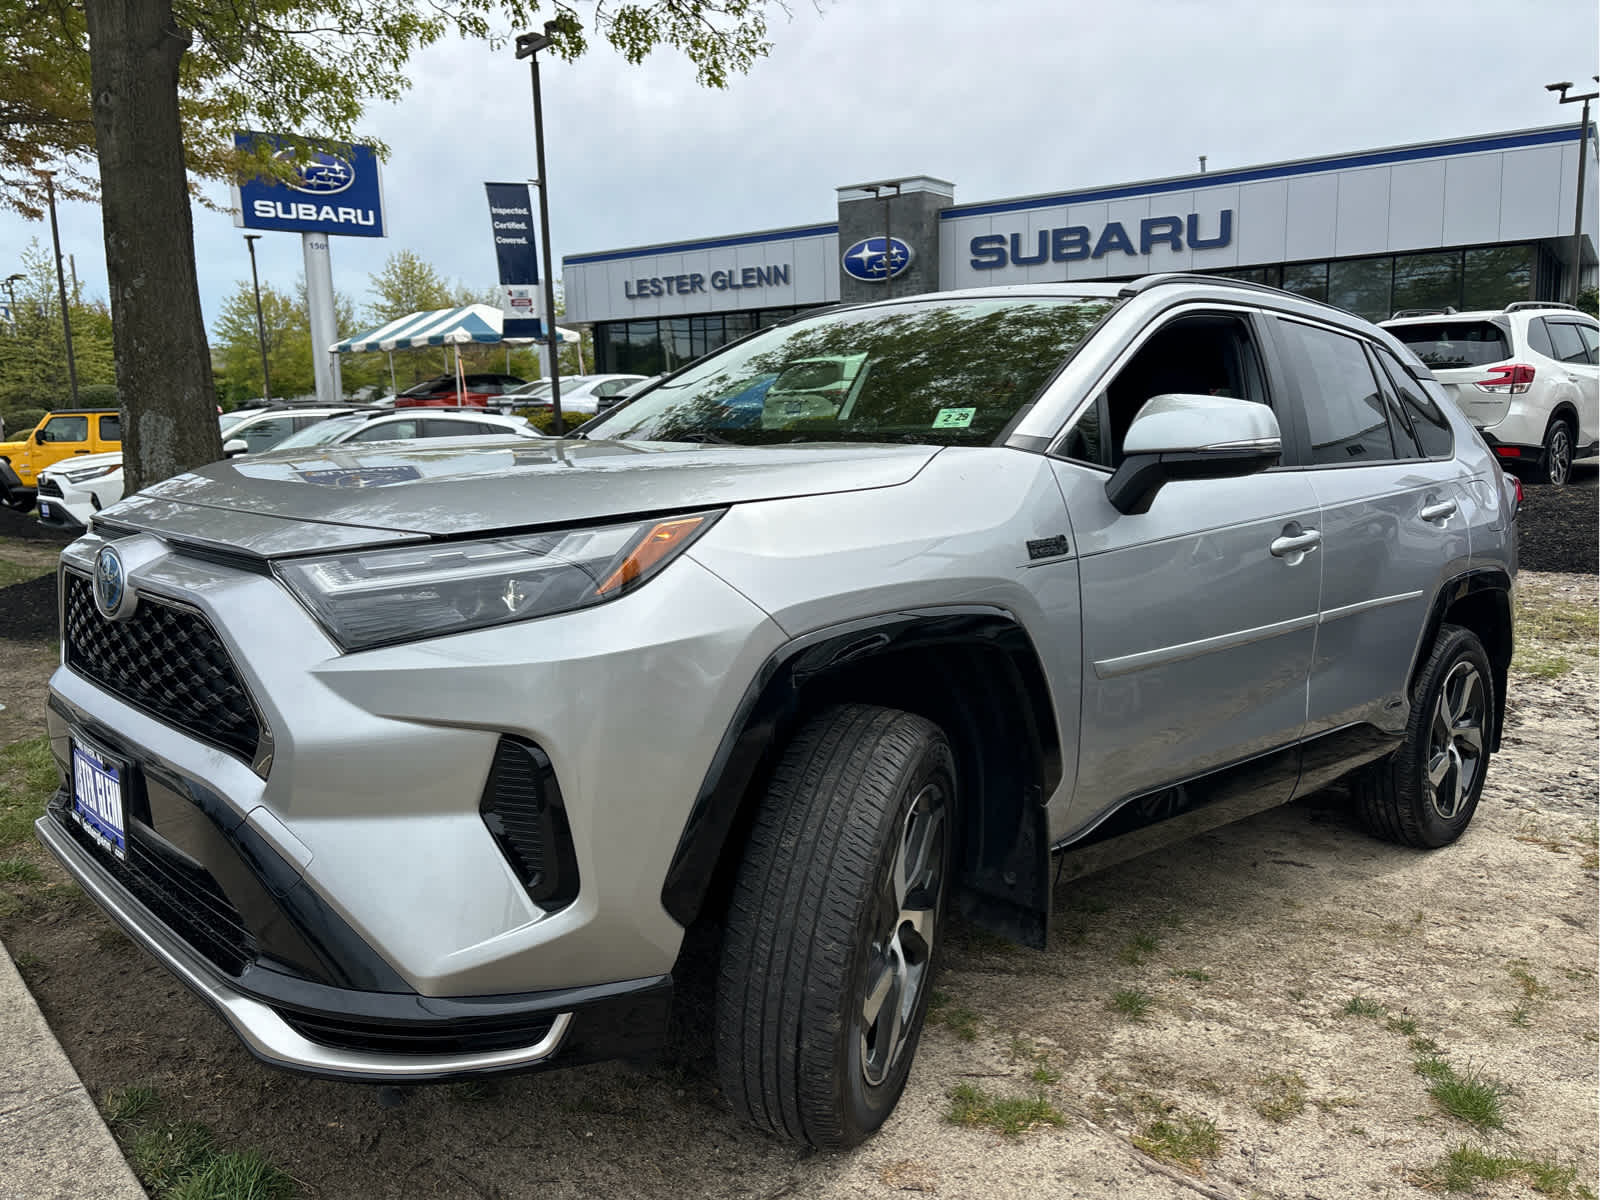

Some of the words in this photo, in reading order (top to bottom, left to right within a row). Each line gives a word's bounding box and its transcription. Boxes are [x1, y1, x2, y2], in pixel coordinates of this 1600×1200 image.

[253, 200, 375, 226] SUBARU
[491, 206, 529, 216] Inspected.
[494, 221, 528, 230] Certified.
[495, 236, 529, 245] Covered.
[970, 209, 1232, 271] SUBARU
[624, 273, 707, 300] LESTER
[711, 264, 791, 291] GLENN
